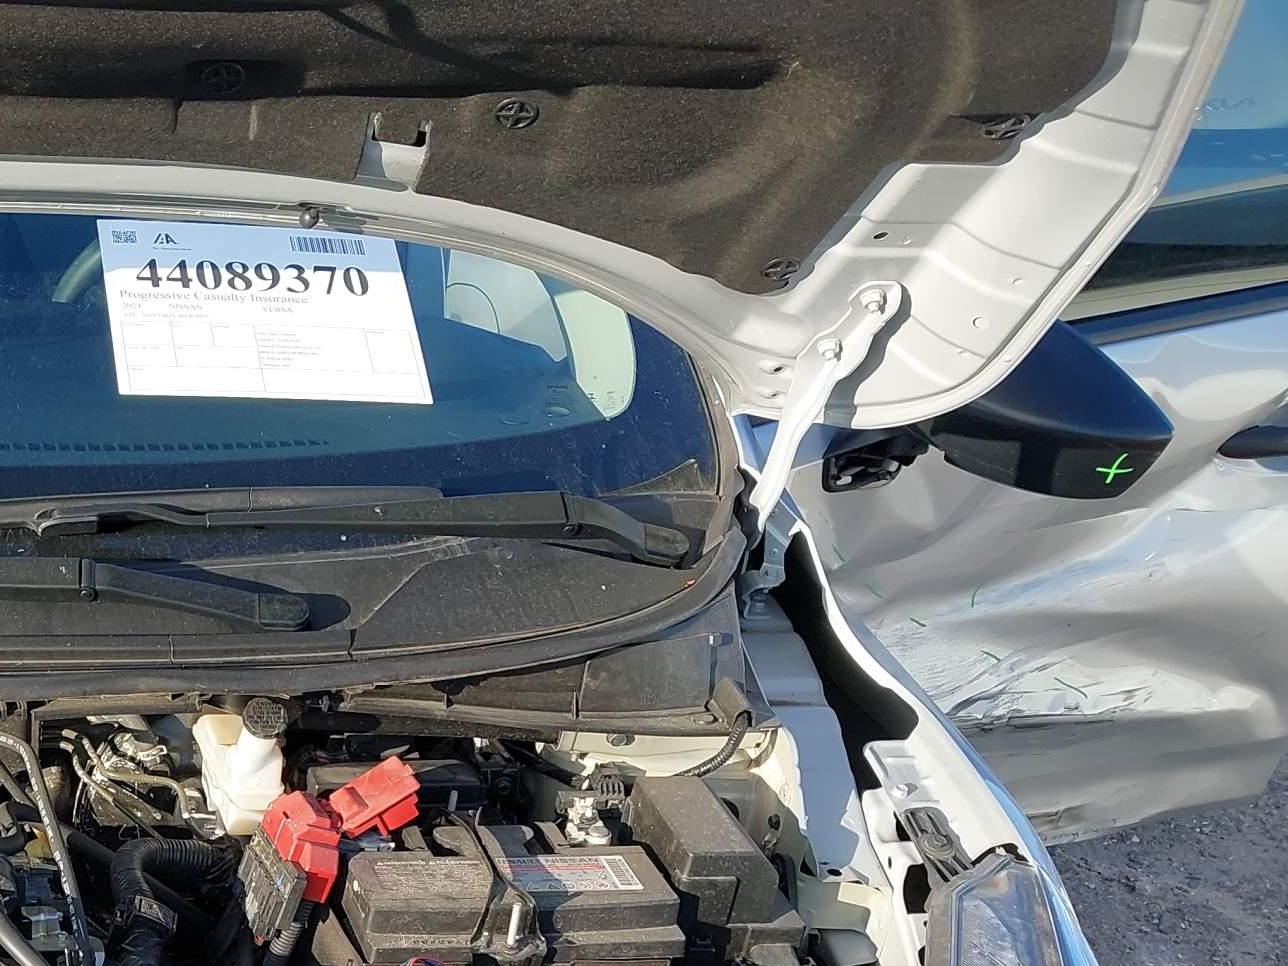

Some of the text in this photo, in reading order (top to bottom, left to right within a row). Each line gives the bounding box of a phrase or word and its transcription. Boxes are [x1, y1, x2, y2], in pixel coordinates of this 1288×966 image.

[136, 258, 369, 297] 44089370
[120, 289, 309, 304] Progressive Casualty Insurance
